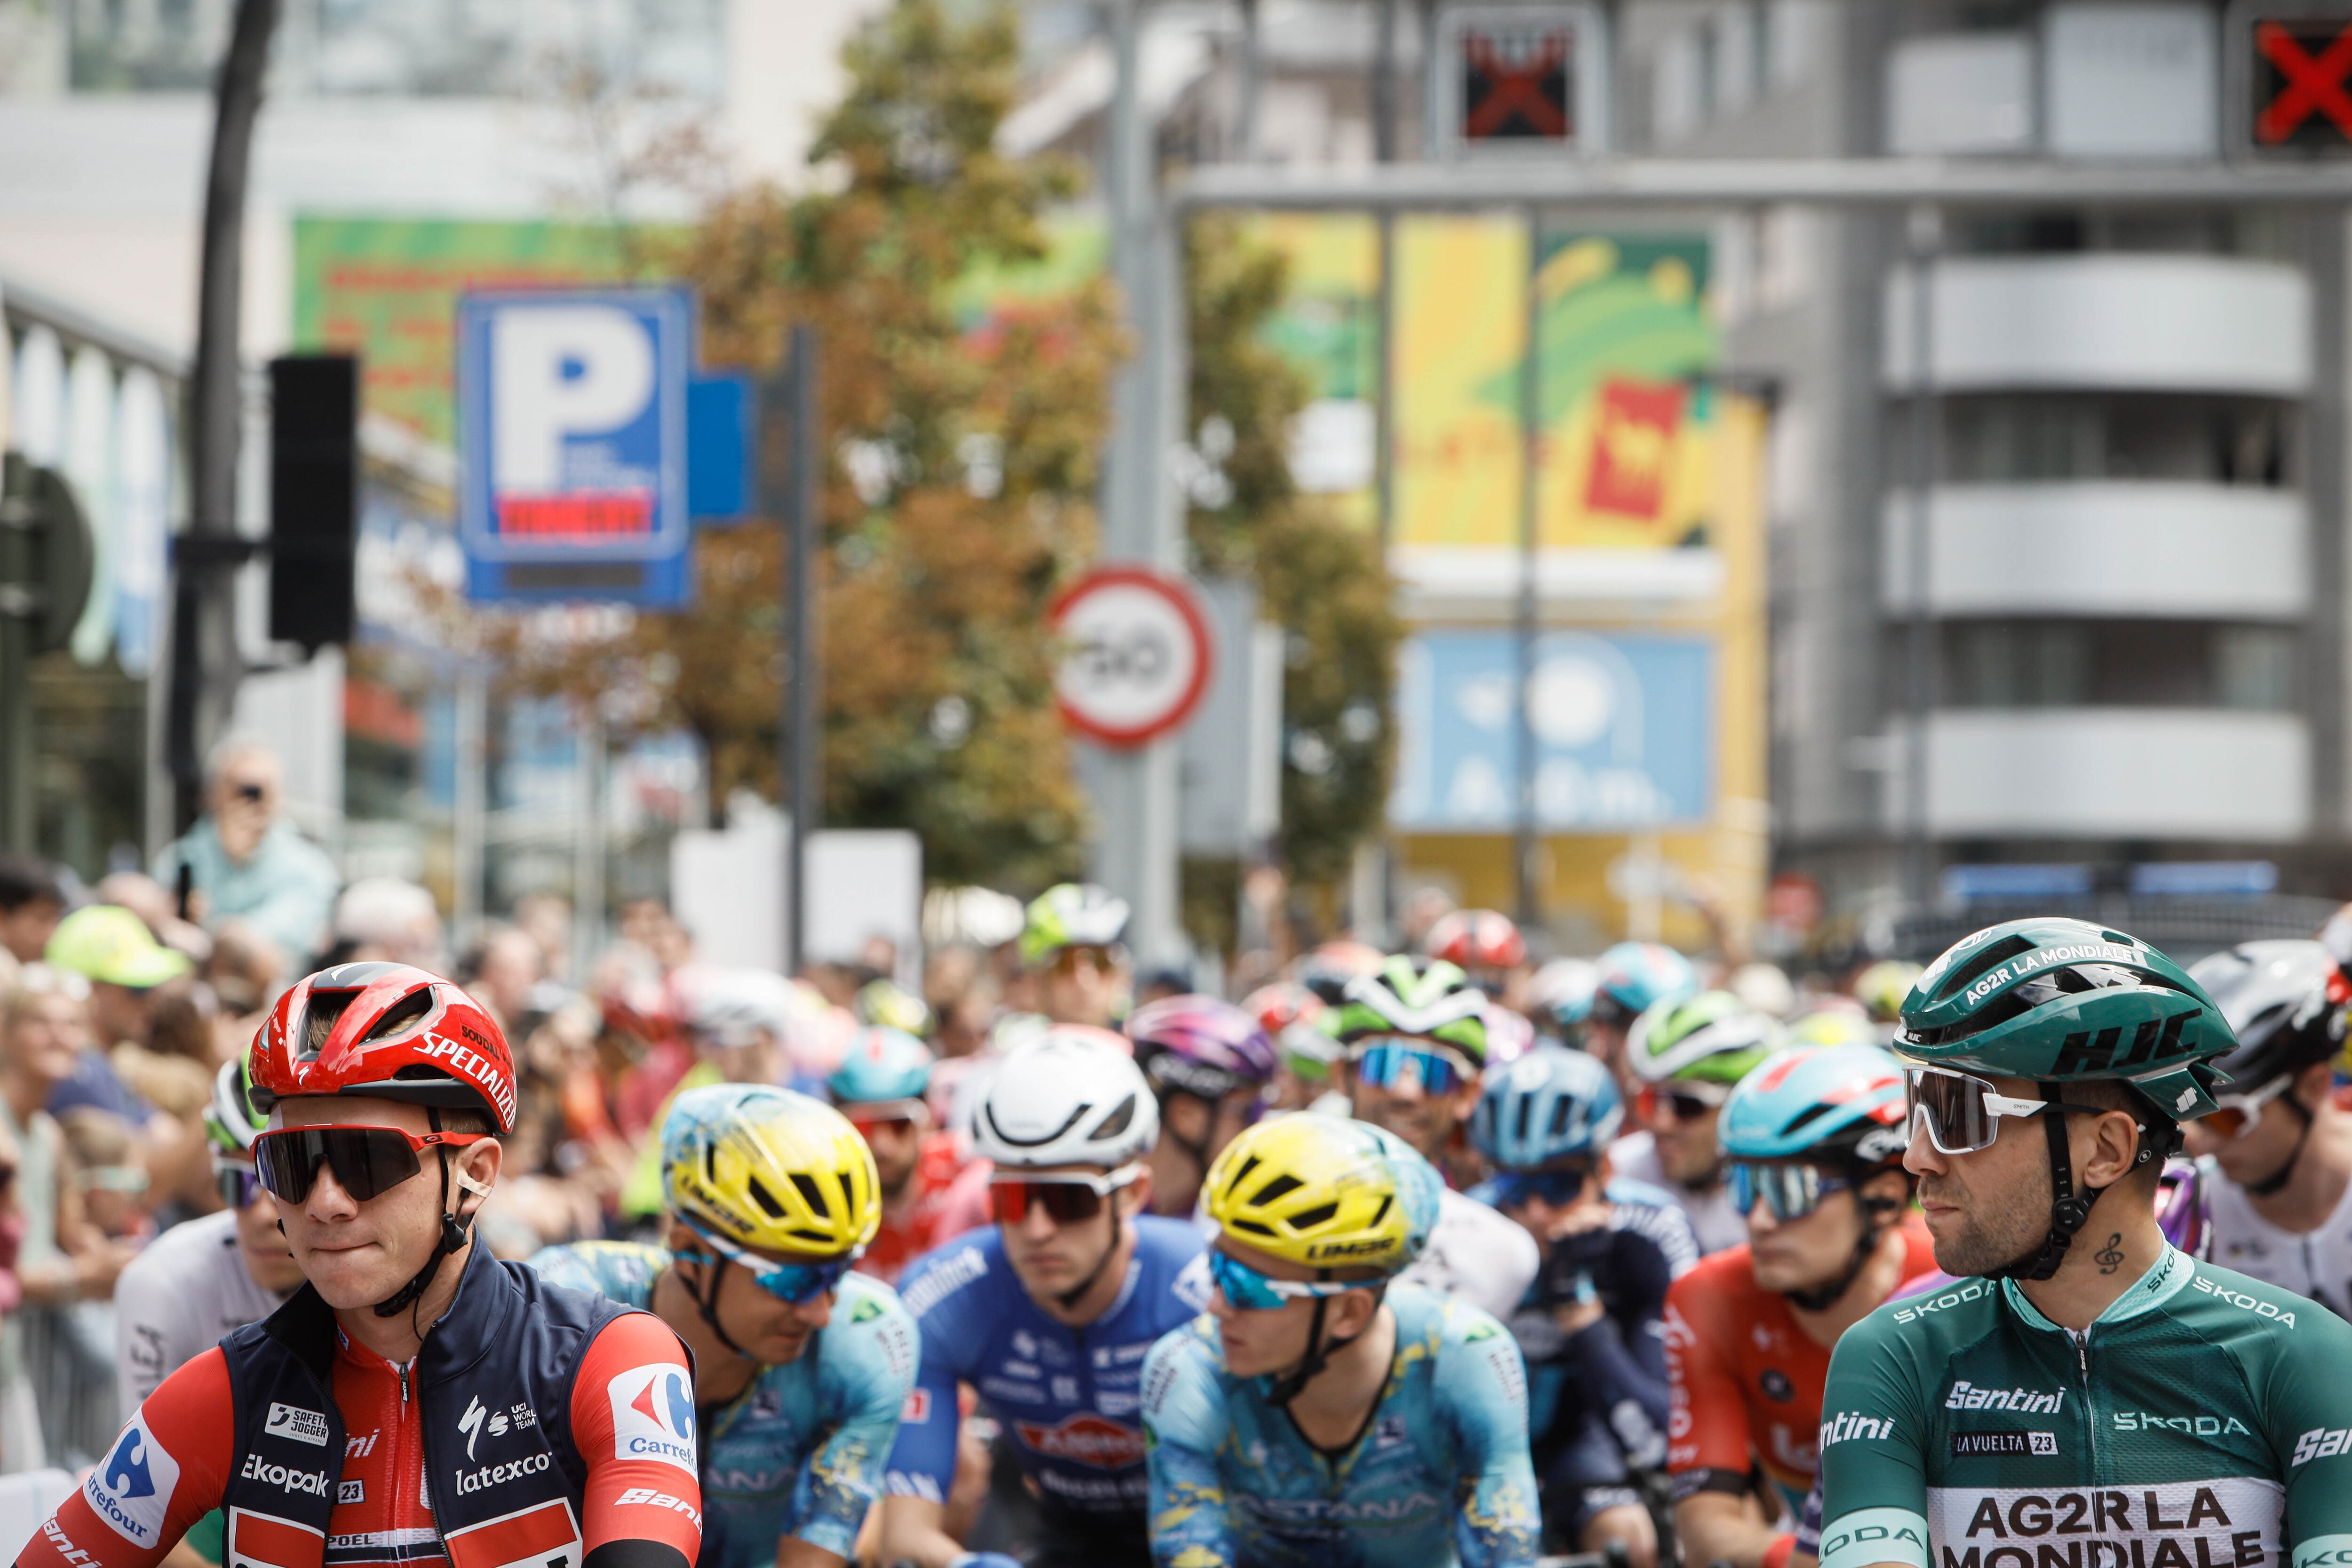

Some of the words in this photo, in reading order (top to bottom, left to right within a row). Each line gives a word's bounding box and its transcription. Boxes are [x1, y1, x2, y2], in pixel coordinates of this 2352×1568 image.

[490, 303, 656, 492] P
[1966, 967, 2012, 1005] AG2R
[2011, 956, 2040, 975] LA
[2040, 946, 2133, 964] MONDIALE
[461, 1025, 500, 1061] SOUDAL
[2051, 1008, 2202, 1075] HJC
[413, 1031, 516, 1130] SPECIALIZED
[511, 1402, 526, 1414] UCI
[513, 1409, 537, 1422] WORL
[1945, 1381, 2066, 1413] Santini
[291, 1421, 327, 1438] JOGGER
[515, 1417, 536, 1430] TEAM
[1820, 1412, 1896, 1455] ntini
[1957, 1438, 1970, 1452] LA
[1972, 1436, 2024, 1450] VUELTA
[2034, 1436, 2052, 1451] 23
[241, 1454, 329, 1497] Ekopak
[341, 1485, 359, 1500] 23
[455, 1454, 549, 1496] latexco
[88, 1472, 148, 1537] arrefour
[1965, 1491, 2134, 1538] AG2R
[2144, 1488, 2232, 1530] LA
[328, 1535, 374, 1546] POEL
